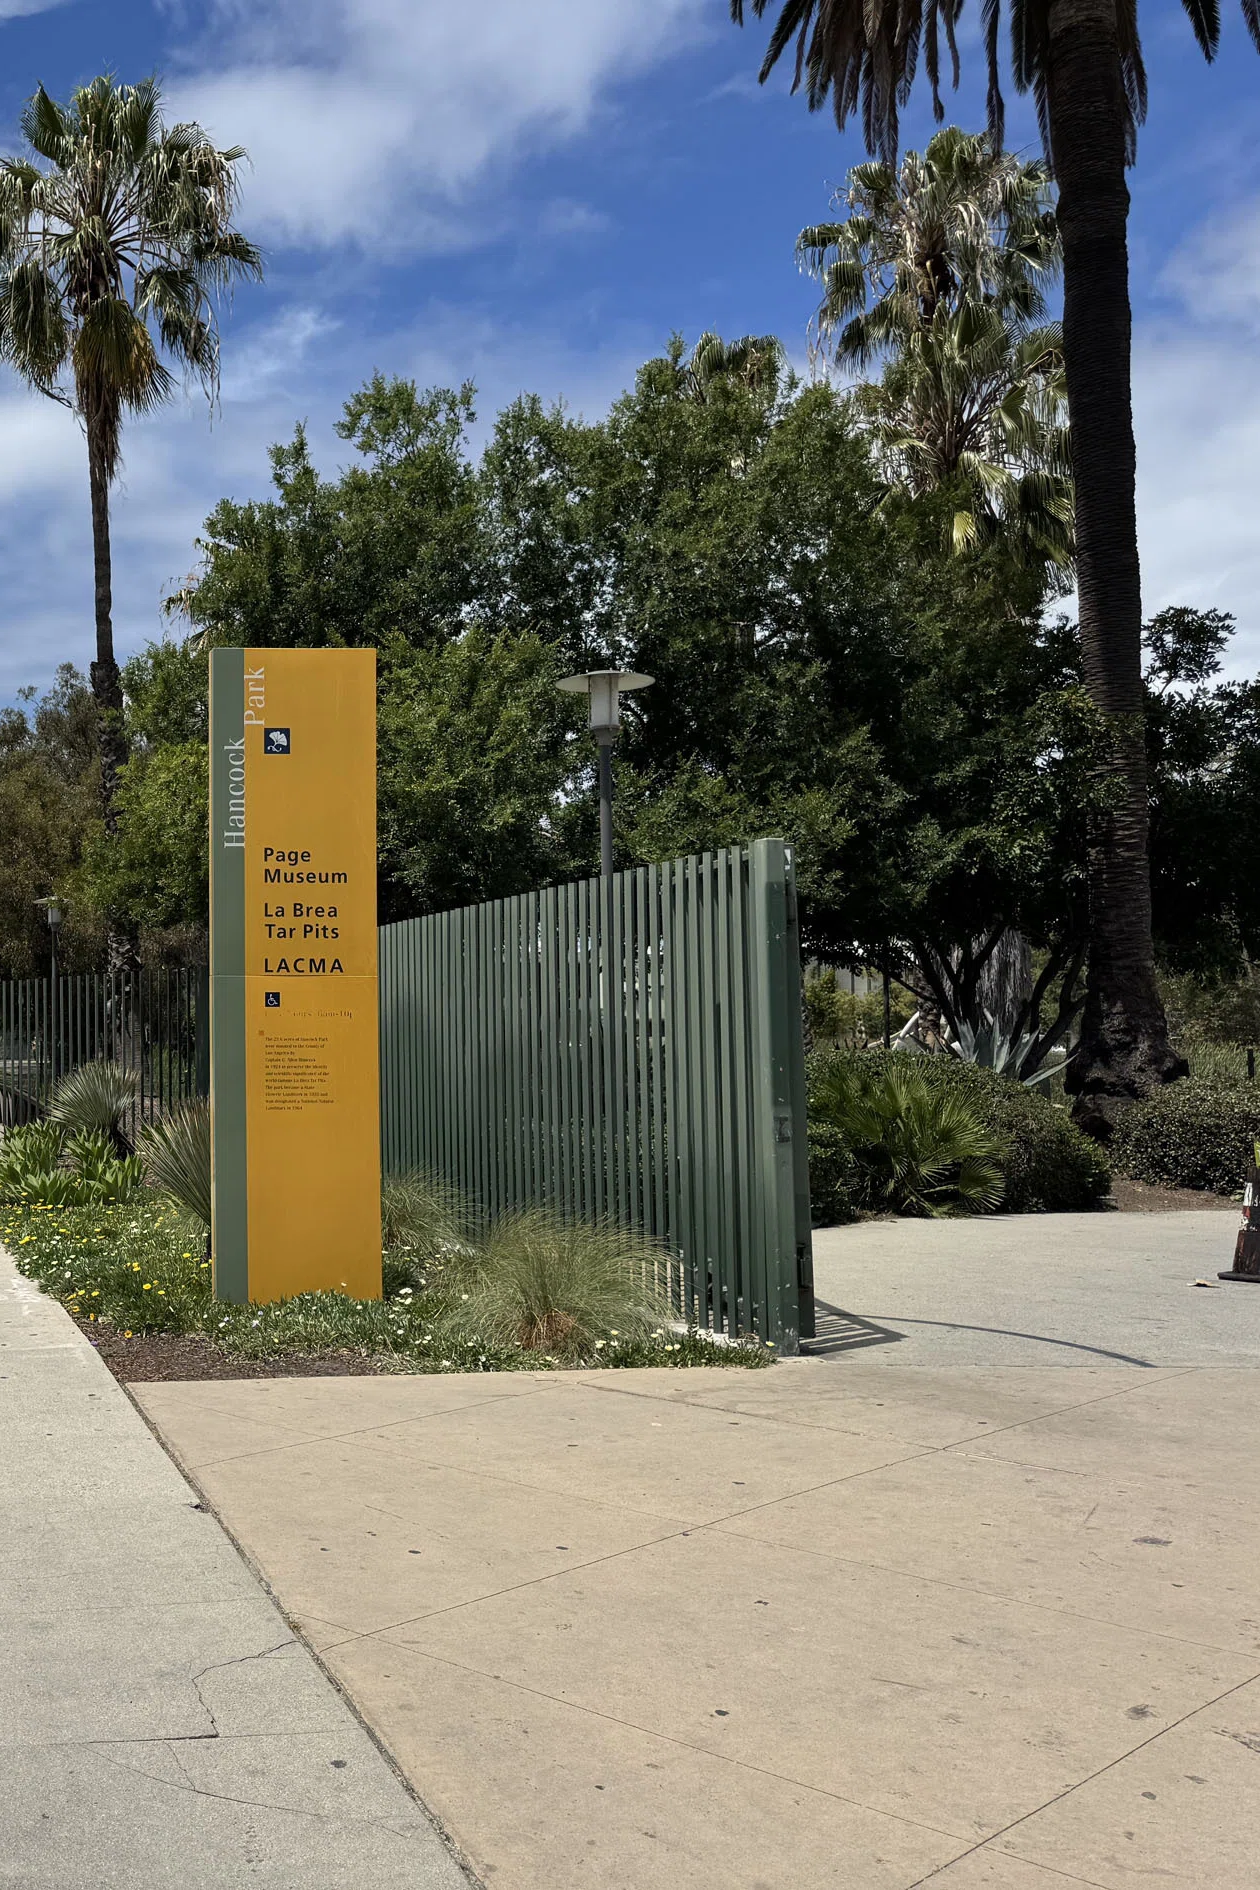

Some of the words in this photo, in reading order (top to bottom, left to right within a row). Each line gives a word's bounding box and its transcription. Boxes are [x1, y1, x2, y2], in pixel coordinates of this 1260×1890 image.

[224, 738, 245, 848] Hancock
[244, 666, 265, 726] Park
[264, 848, 311, 866] Page
[264, 868, 348, 883] Museum
[264, 903, 285, 917] La
[293, 903, 338, 917] Brea
[264, 924, 296, 939] Tar
[303, 924, 339, 939] Pits
[264, 958, 344, 973] LACMA
